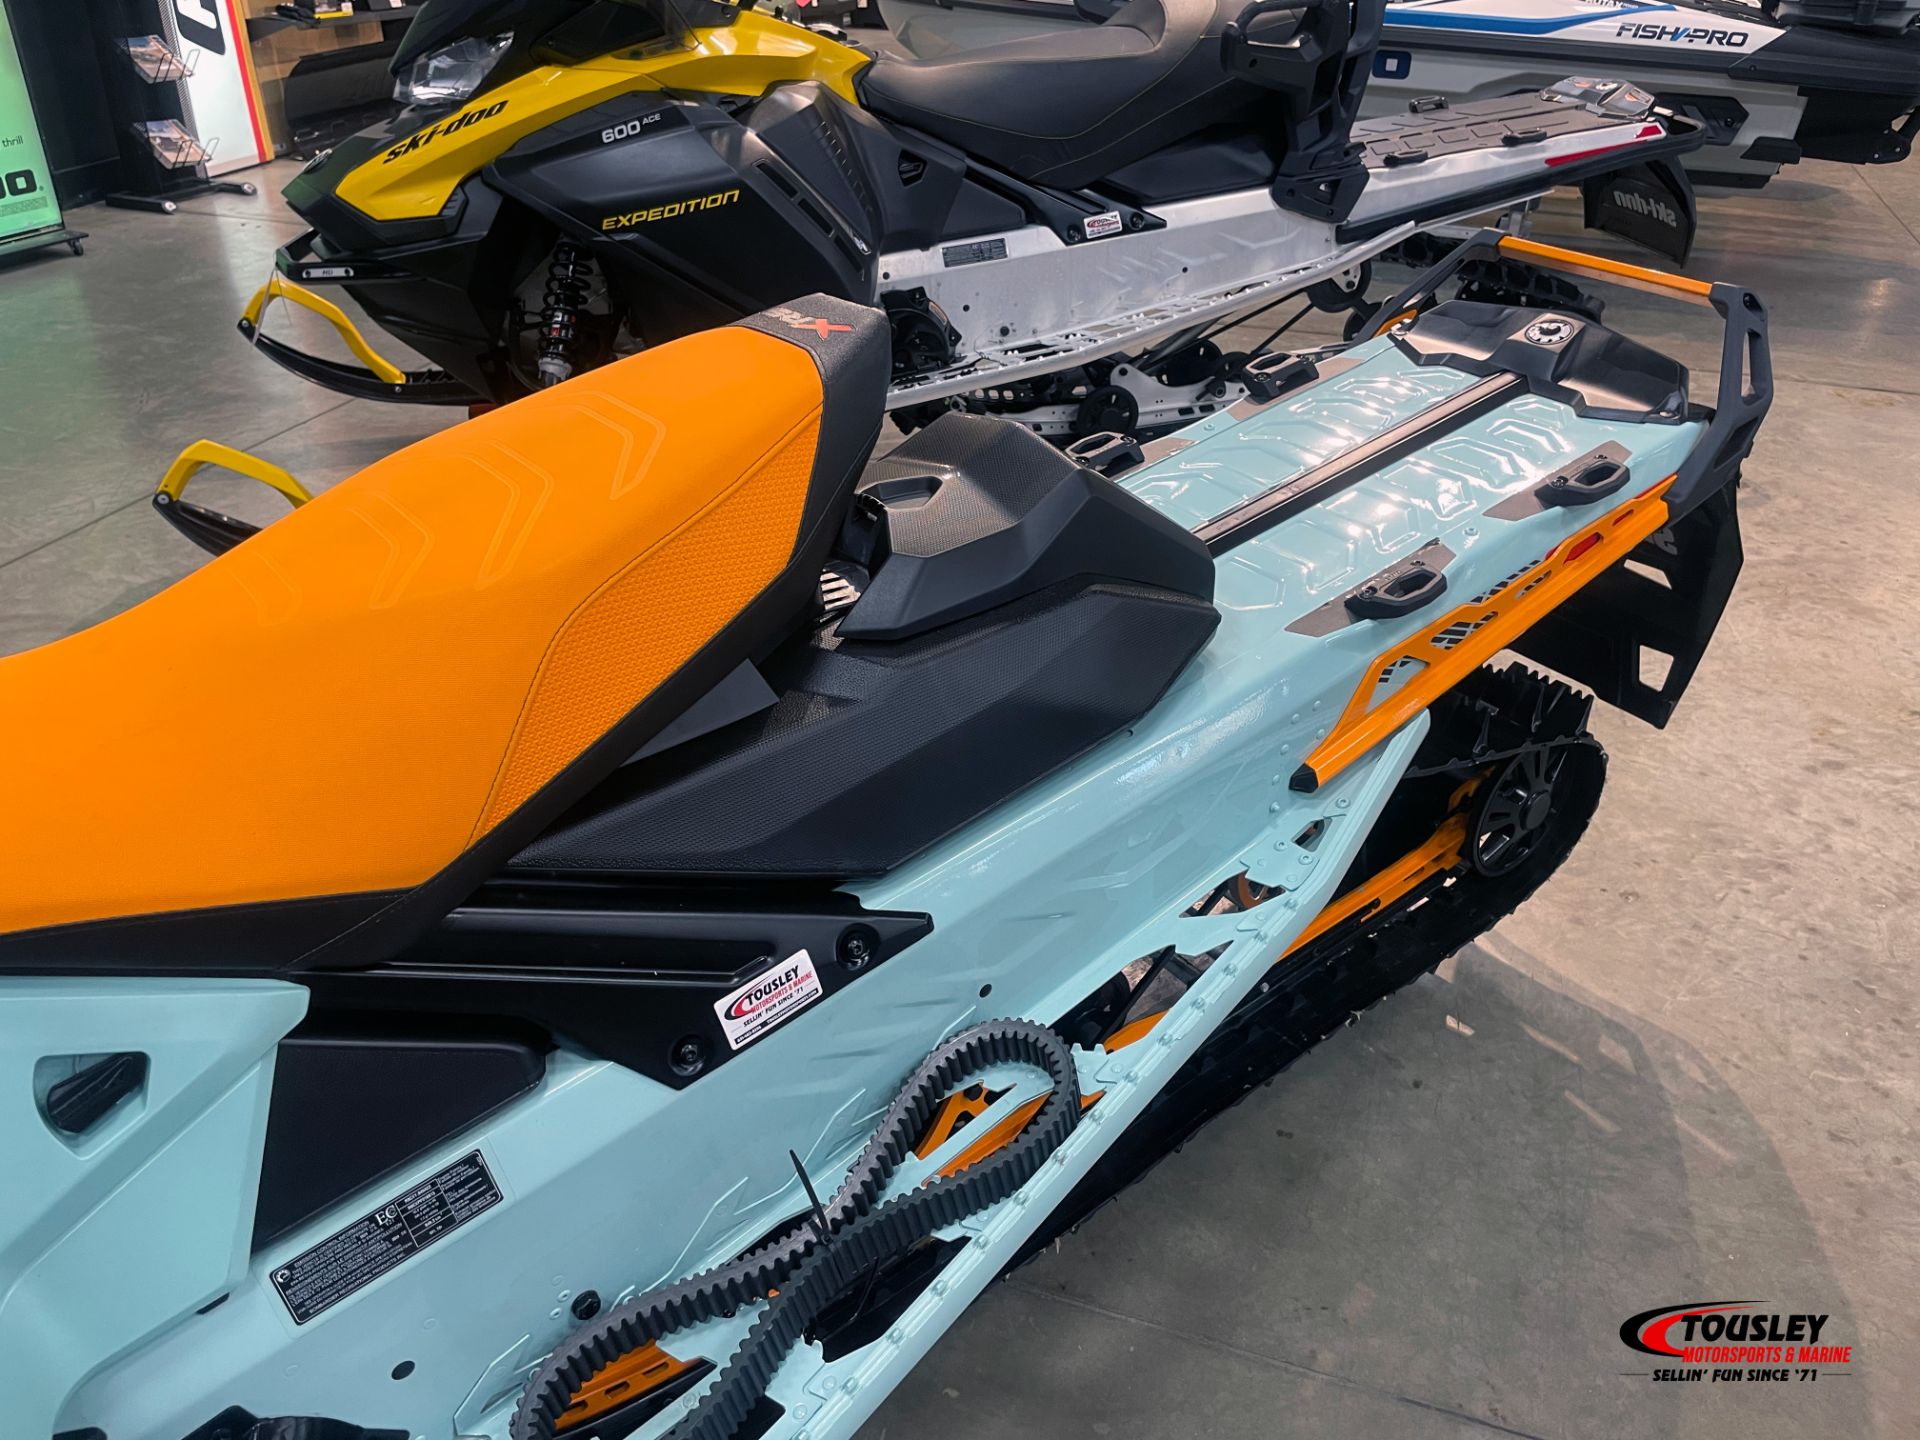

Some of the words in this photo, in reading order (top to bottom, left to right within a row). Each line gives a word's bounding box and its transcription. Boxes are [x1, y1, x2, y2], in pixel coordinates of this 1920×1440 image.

[2, 135, 24, 147] thrill
[602, 119, 641, 144] 600
[642, 112, 662, 125] ACE
[602, 189, 741, 231] EXPEDITION
[745, 965, 799, 1006] TOUSLEY
[751, 986, 788, 1014] MOTORSPORTS
[793, 971, 814, 988] MARINE
[765, 1004, 777, 1015] FUN
[778, 993, 794, 1006] SINCE
